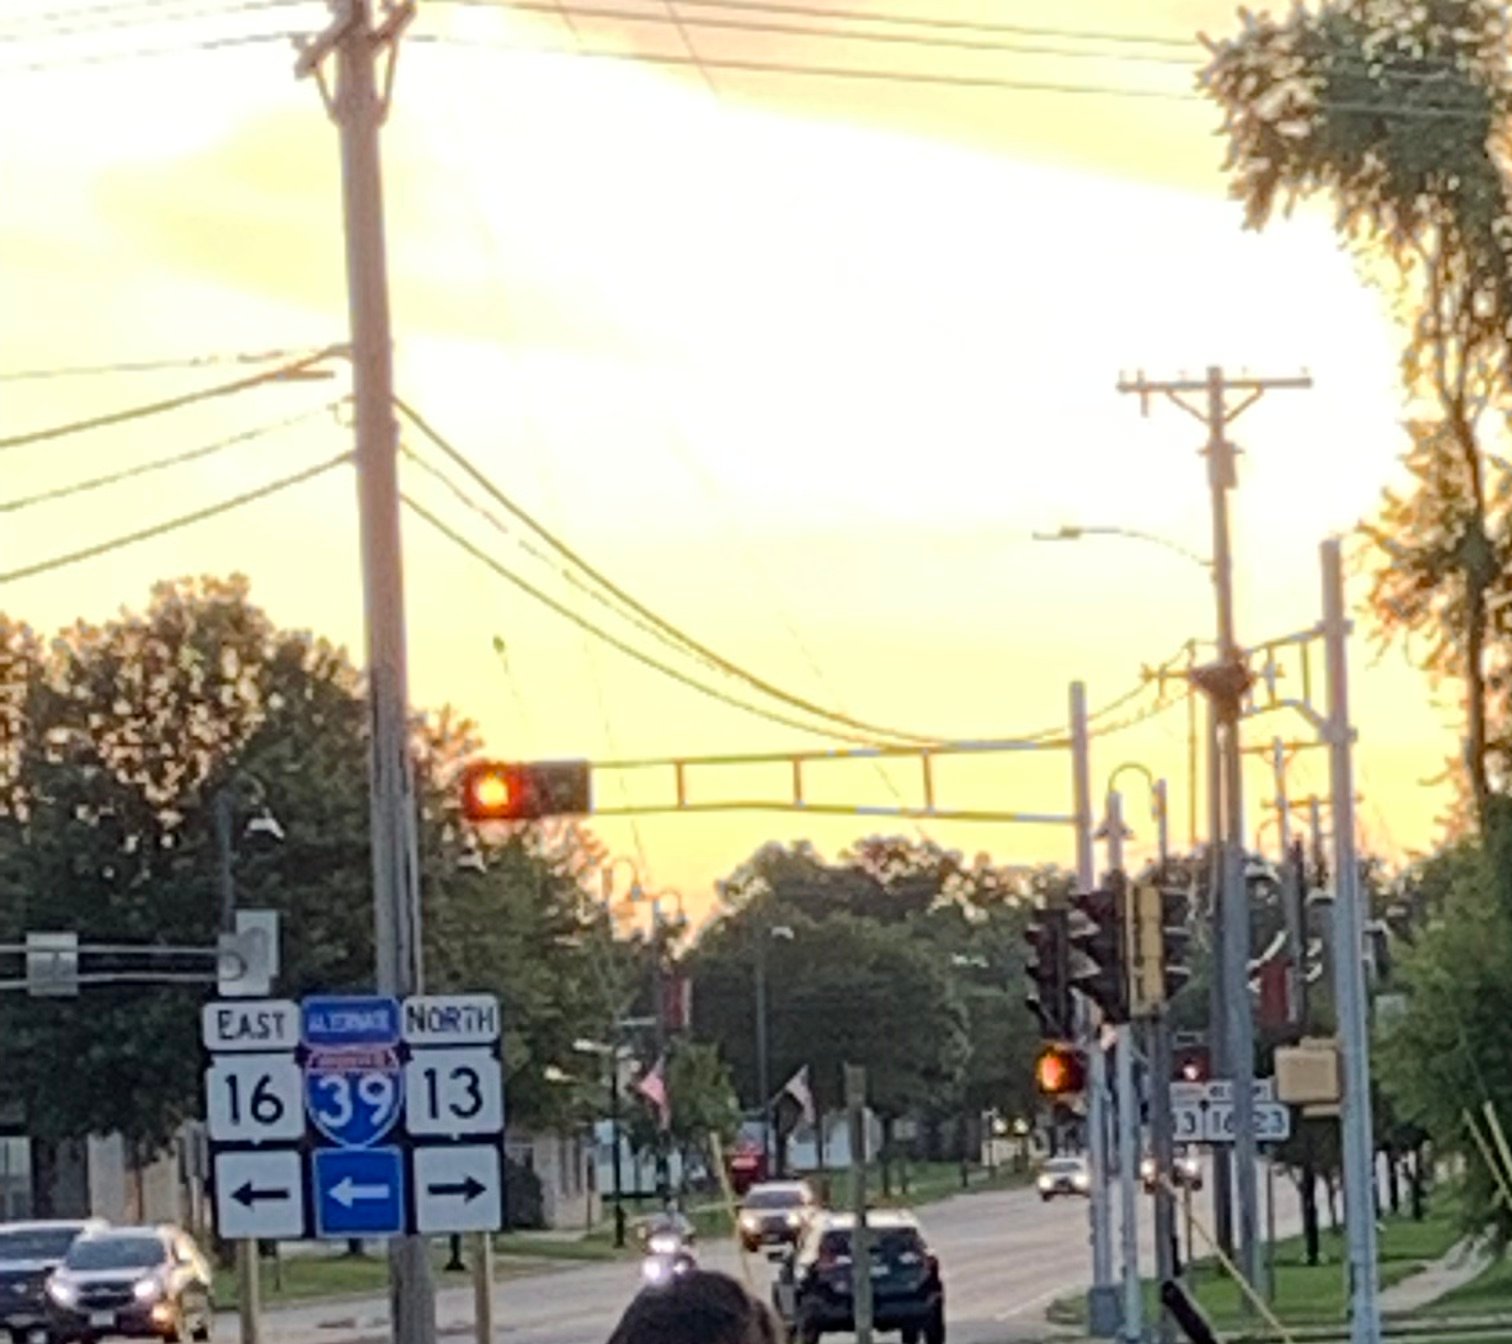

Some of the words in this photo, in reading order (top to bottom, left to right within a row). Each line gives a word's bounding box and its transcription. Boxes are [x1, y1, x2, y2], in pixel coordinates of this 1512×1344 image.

[217, 1009, 287, 1040] EAST
[406, 1004, 495, 1035] NORTH
[225, 1073, 284, 1125] 16
[317, 1073, 394, 1128] 39
[424, 1066, 484, 1119] 13
